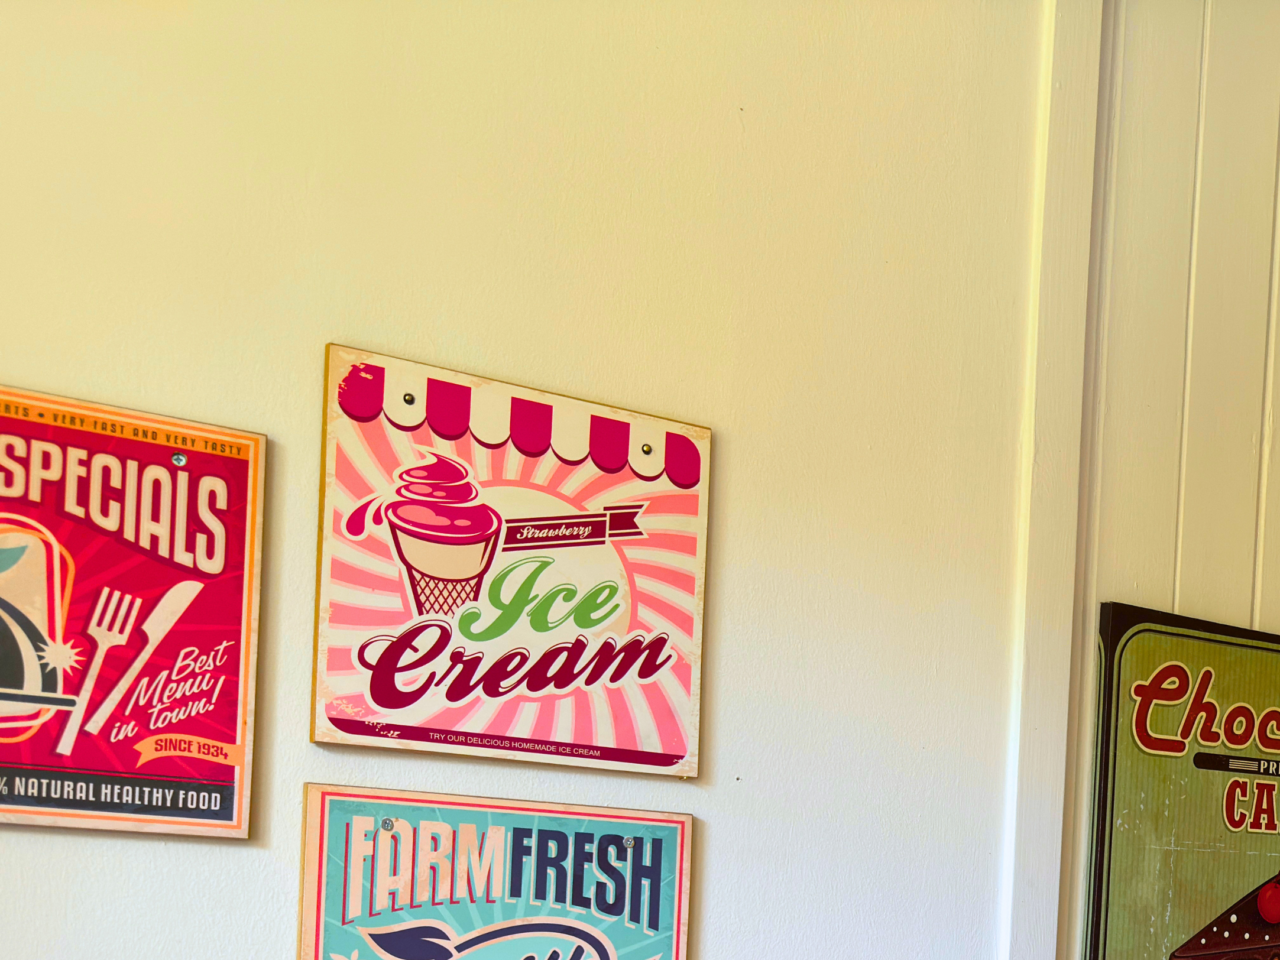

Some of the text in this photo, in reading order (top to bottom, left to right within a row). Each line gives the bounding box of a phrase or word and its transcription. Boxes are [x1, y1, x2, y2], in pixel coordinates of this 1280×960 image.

[53, 412, 85, 428] VERY
[93, 419, 126, 436] FAST
[133, 428, 159, 442] AND
[166, 433, 197, 449] VERY
[203, 440, 243, 457] TASTY
[0, 433, 229, 576] SPECIALS
[516, 523, 592, 540] Strawberry
[457, 555, 620, 643] Ice
[170, 640, 235, 681] Best
[357, 618, 673, 710] Cream
[109, 675, 227, 743] in town!
[124, 669, 217, 716] Menu
[153, 737, 229, 761] SINCE 1934
[429, 732, 601, 757] TRY OUR DELICIOUS HOMEMADE ICE CREAM
[13, 776, 96, 801] NATURAL
[101, 783, 174, 808] HEALTHY
[178, 790, 222, 811] FOOD
[343, 815, 664, 935] FARM FRESH
